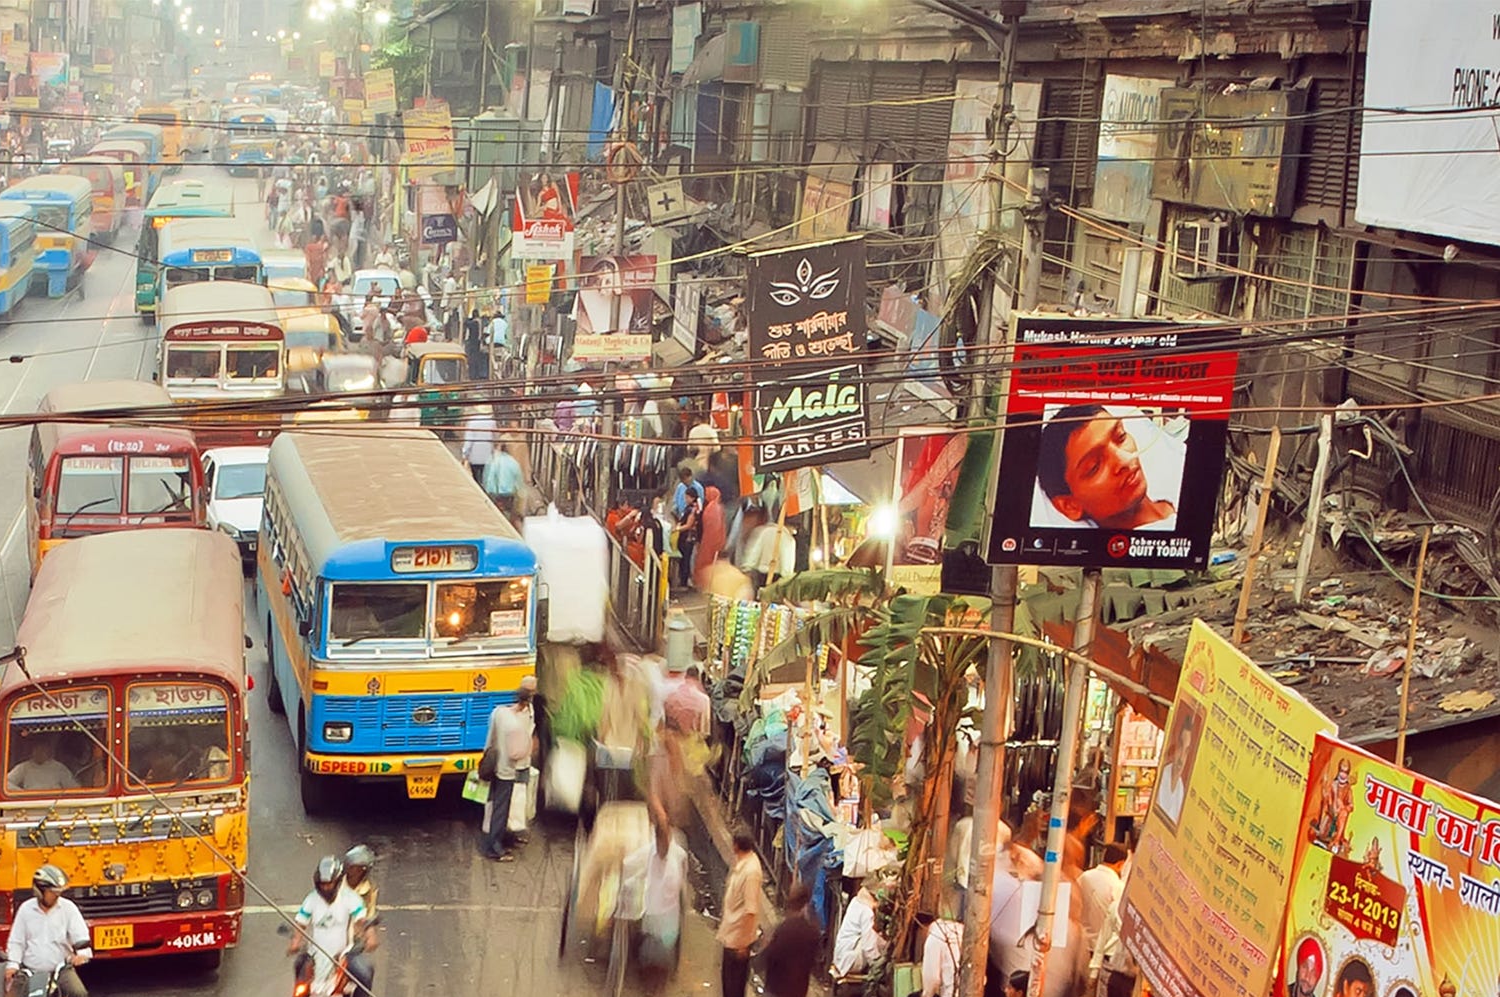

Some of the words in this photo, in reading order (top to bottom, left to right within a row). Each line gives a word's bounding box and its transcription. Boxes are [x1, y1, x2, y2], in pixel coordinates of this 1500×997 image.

[768, 322, 793, 339] শুভ
[1159, 334, 1178, 347] old
[1140, 358, 1211, 379] Cancer
[764, 427, 862, 460] SAREES
[1130, 536, 1168, 547] Tobacco
[1169, 537, 1193, 548] Kills
[1128, 545, 1156, 557] QUIT
[1156, 546, 1192, 559] TODAY
[321, 760, 367, 773] SPEED
[1366, 775, 1432, 835] माता
[1435, 804, 1479, 854] का
[1407, 851, 1453, 890] स्थान-
[1329, 880, 1399, 930] 23-1-2013
